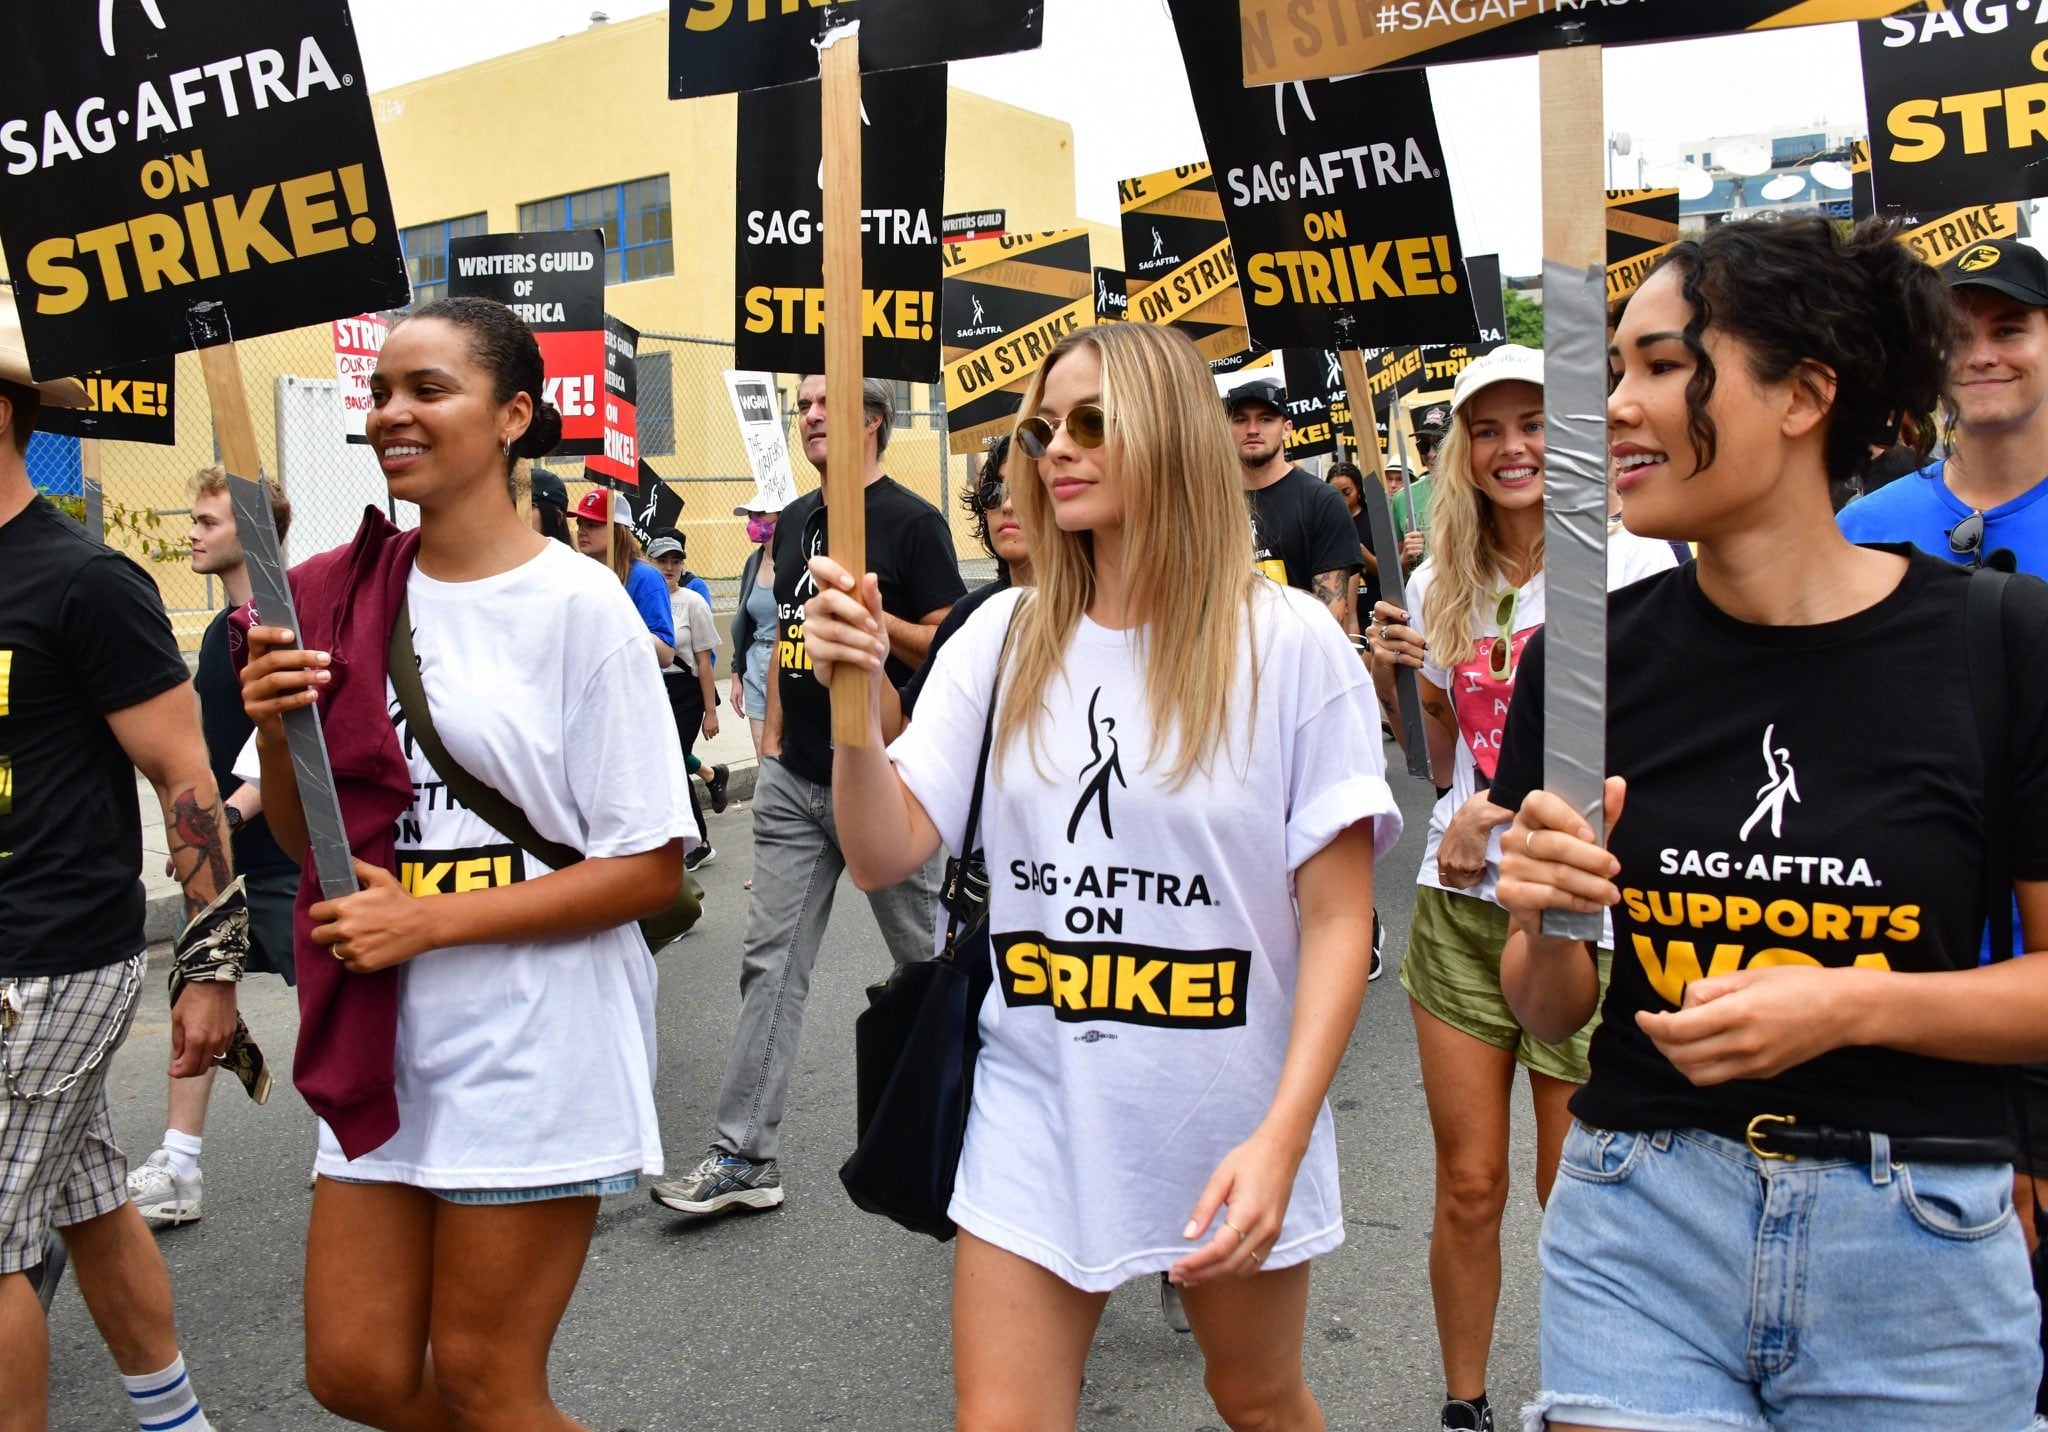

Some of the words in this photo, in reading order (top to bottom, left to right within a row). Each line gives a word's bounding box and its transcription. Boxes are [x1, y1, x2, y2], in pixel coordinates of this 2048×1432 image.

[140, 149, 210, 200] ON
[943, 216, 976, 232] WRITERS
[977, 213, 1001, 227] GUILD
[1303, 209, 1347, 242] ON
[1909, 204, 2005, 262] STRIKE
[26, 163, 377, 316] STRIKE!
[458, 252, 537, 277] WRITERS
[540, 251, 594, 273] GUILD
[1247, 235, 1457, 306] STRIKE!
[513, 280, 533, 297] OF
[1139, 286, 1173, 322] ON
[608, 352, 616, 367] OF
[617, 337, 634, 358] GUILD
[957, 356, 995, 393] ON
[994, 311, 1079, 375] STRIKE
[1382, 351, 1395, 366] ON
[1449, 346, 1467, 358] ON
[340, 357, 364, 373] OUR
[1367, 347, 1422, 395] TRIKE!
[605, 403, 619, 424] ON
[740, 396, 768, 410] WGAW
[1331, 402, 1344, 410] ON
[1462, 671, 1484, 693] I
[1065, 906, 1123, 935] ON
[1622, 887, 1921, 942] SUPPORTS
